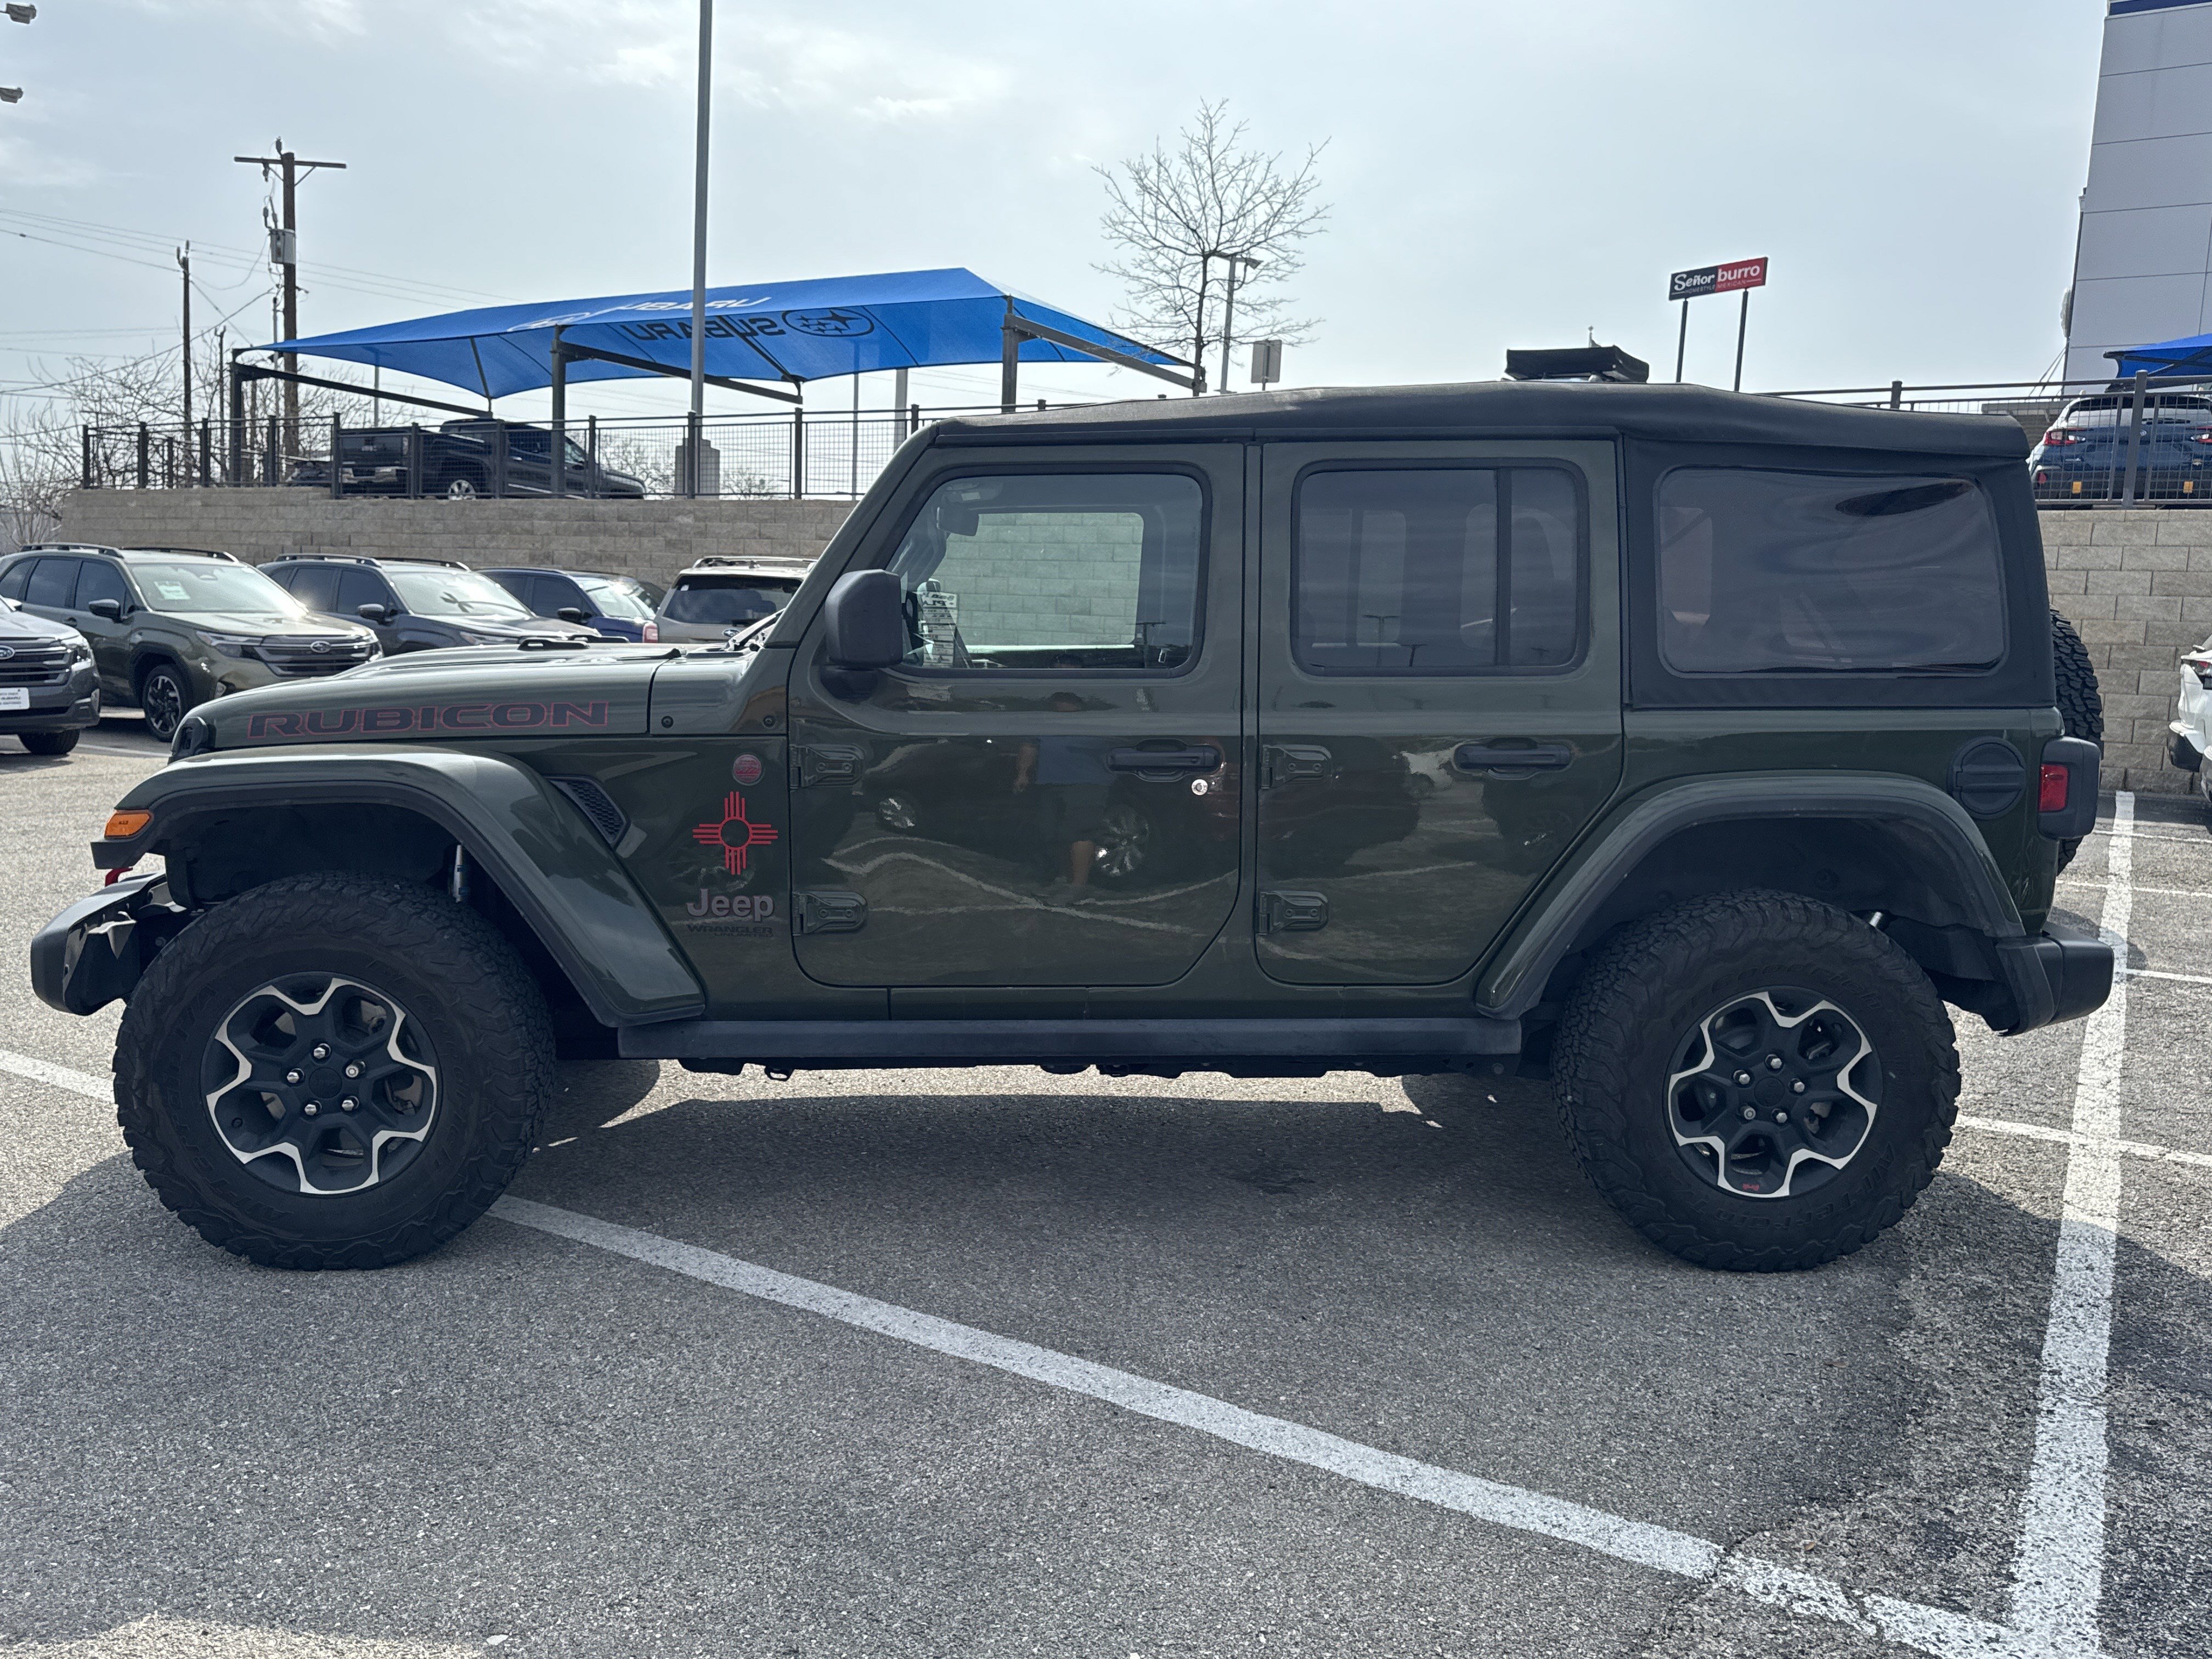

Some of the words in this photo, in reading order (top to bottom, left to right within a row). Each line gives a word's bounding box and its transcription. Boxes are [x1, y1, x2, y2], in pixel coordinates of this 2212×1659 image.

[1674, 273, 1716, 291] Señor
[1717, 266, 1760, 282] burro
[246, 702, 609, 738] RUBICON
[686, 888, 775, 922] Jeep
[686, 924, 774, 933] WRANGLER
